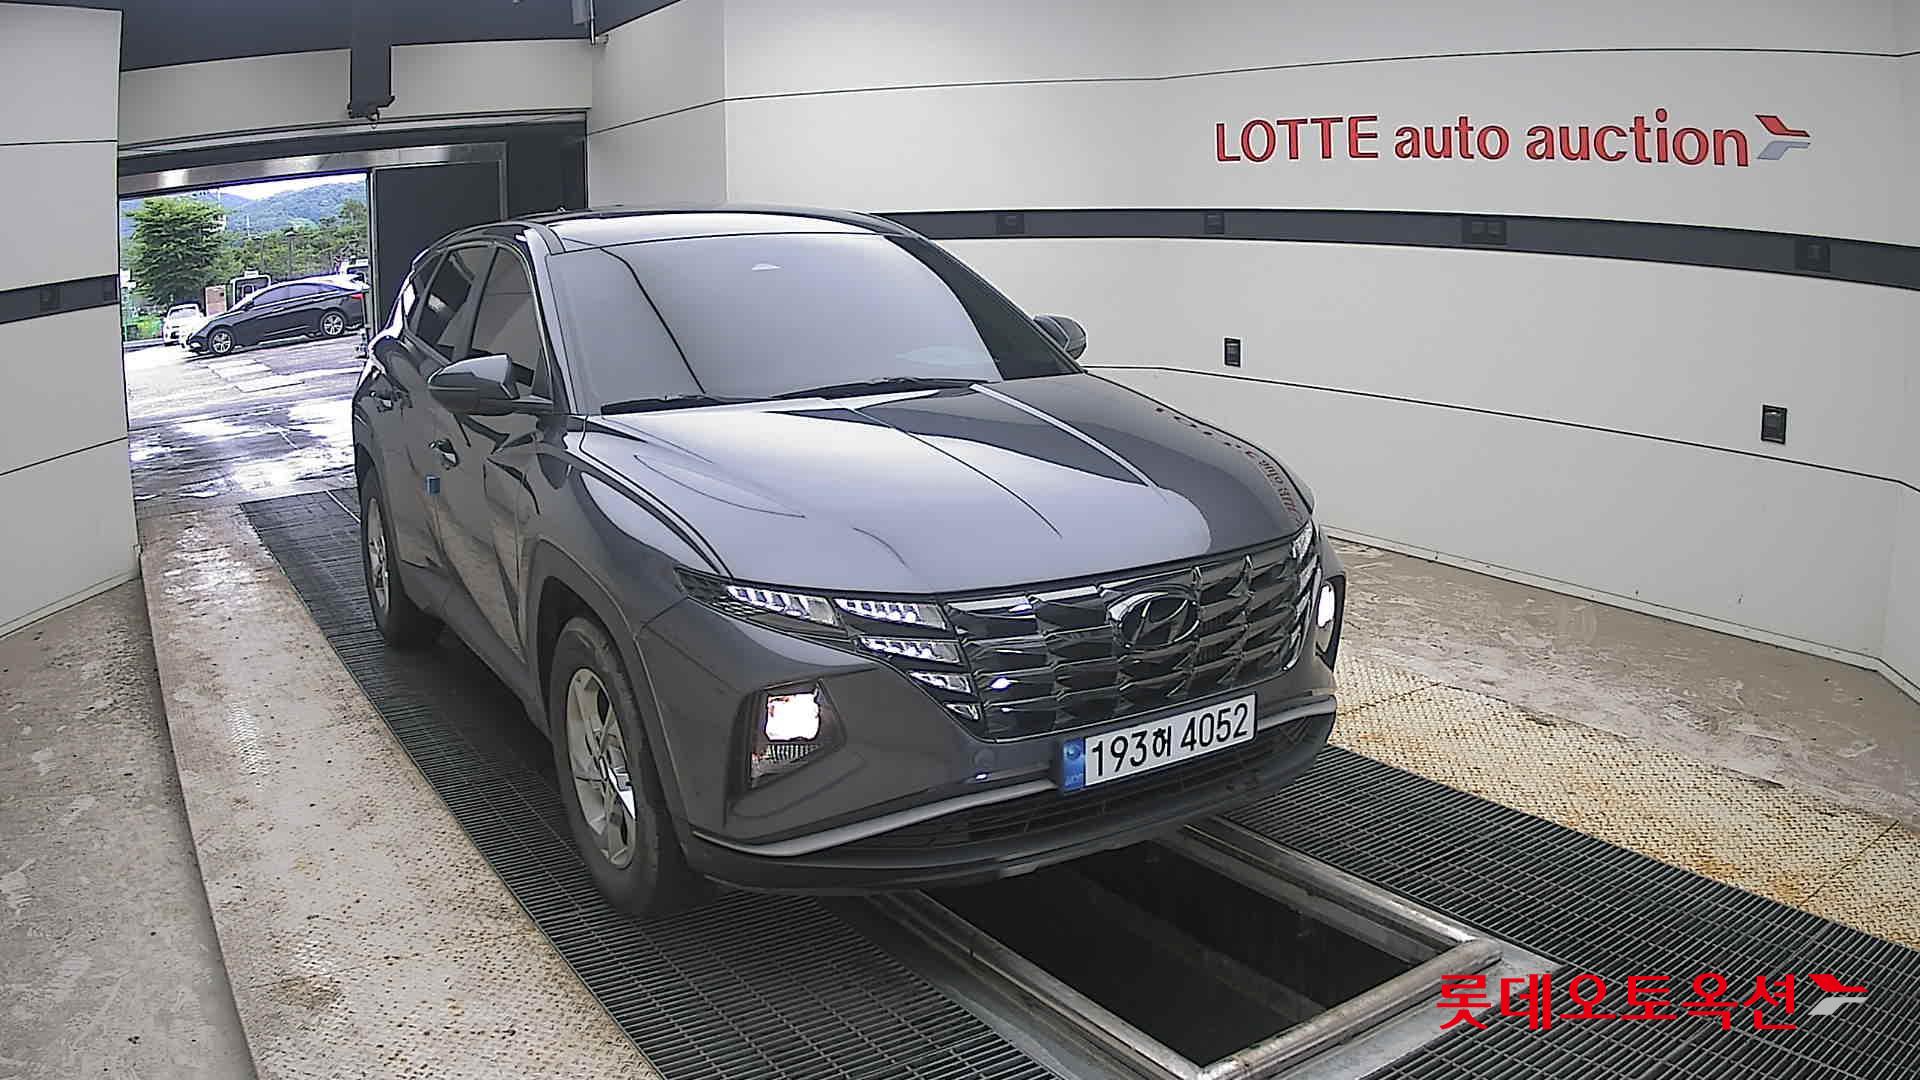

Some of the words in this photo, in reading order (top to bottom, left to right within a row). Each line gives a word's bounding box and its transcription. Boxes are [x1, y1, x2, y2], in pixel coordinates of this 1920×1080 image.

[1215, 115, 1379, 162] LOTTE
[1394, 116, 1511, 161] auto
[1525, 109, 1750, 168] auction
[1092, 725, 1172, 777] 193허
[1180, 703, 1249, 751] 4052
